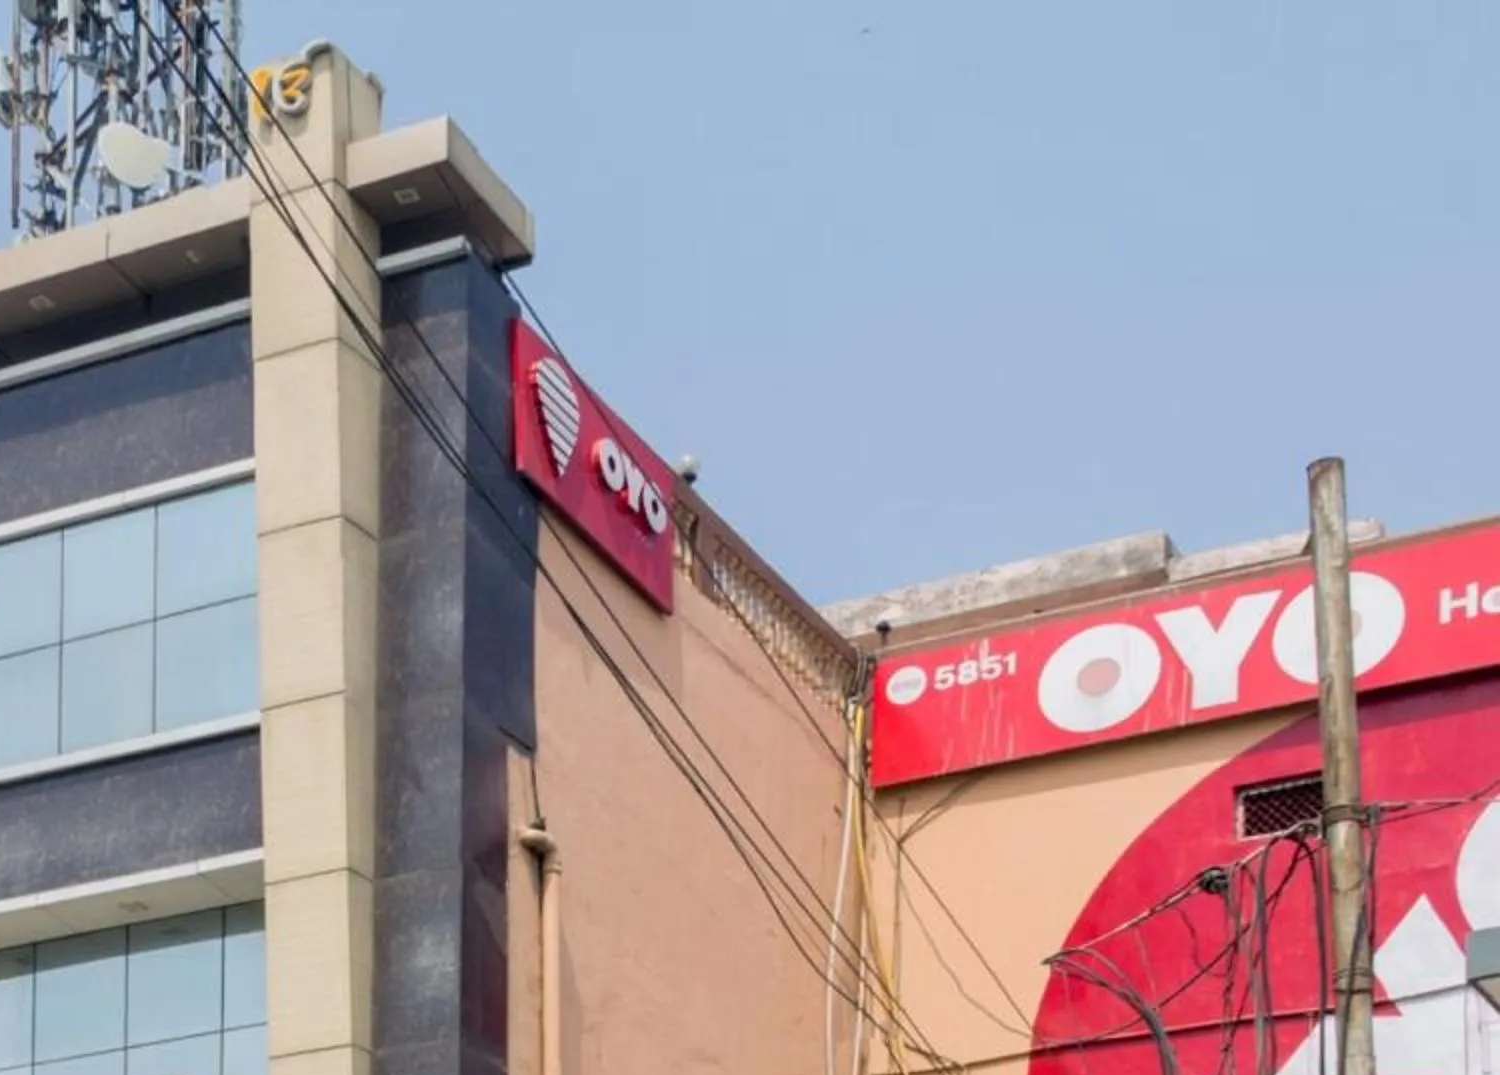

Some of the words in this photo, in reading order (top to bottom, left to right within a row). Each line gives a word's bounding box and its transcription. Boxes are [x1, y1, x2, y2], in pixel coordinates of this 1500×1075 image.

[590, 436, 668, 535] OYO
[933, 650, 1018, 692] 5851
[1037, 570, 1407, 734] OYO
